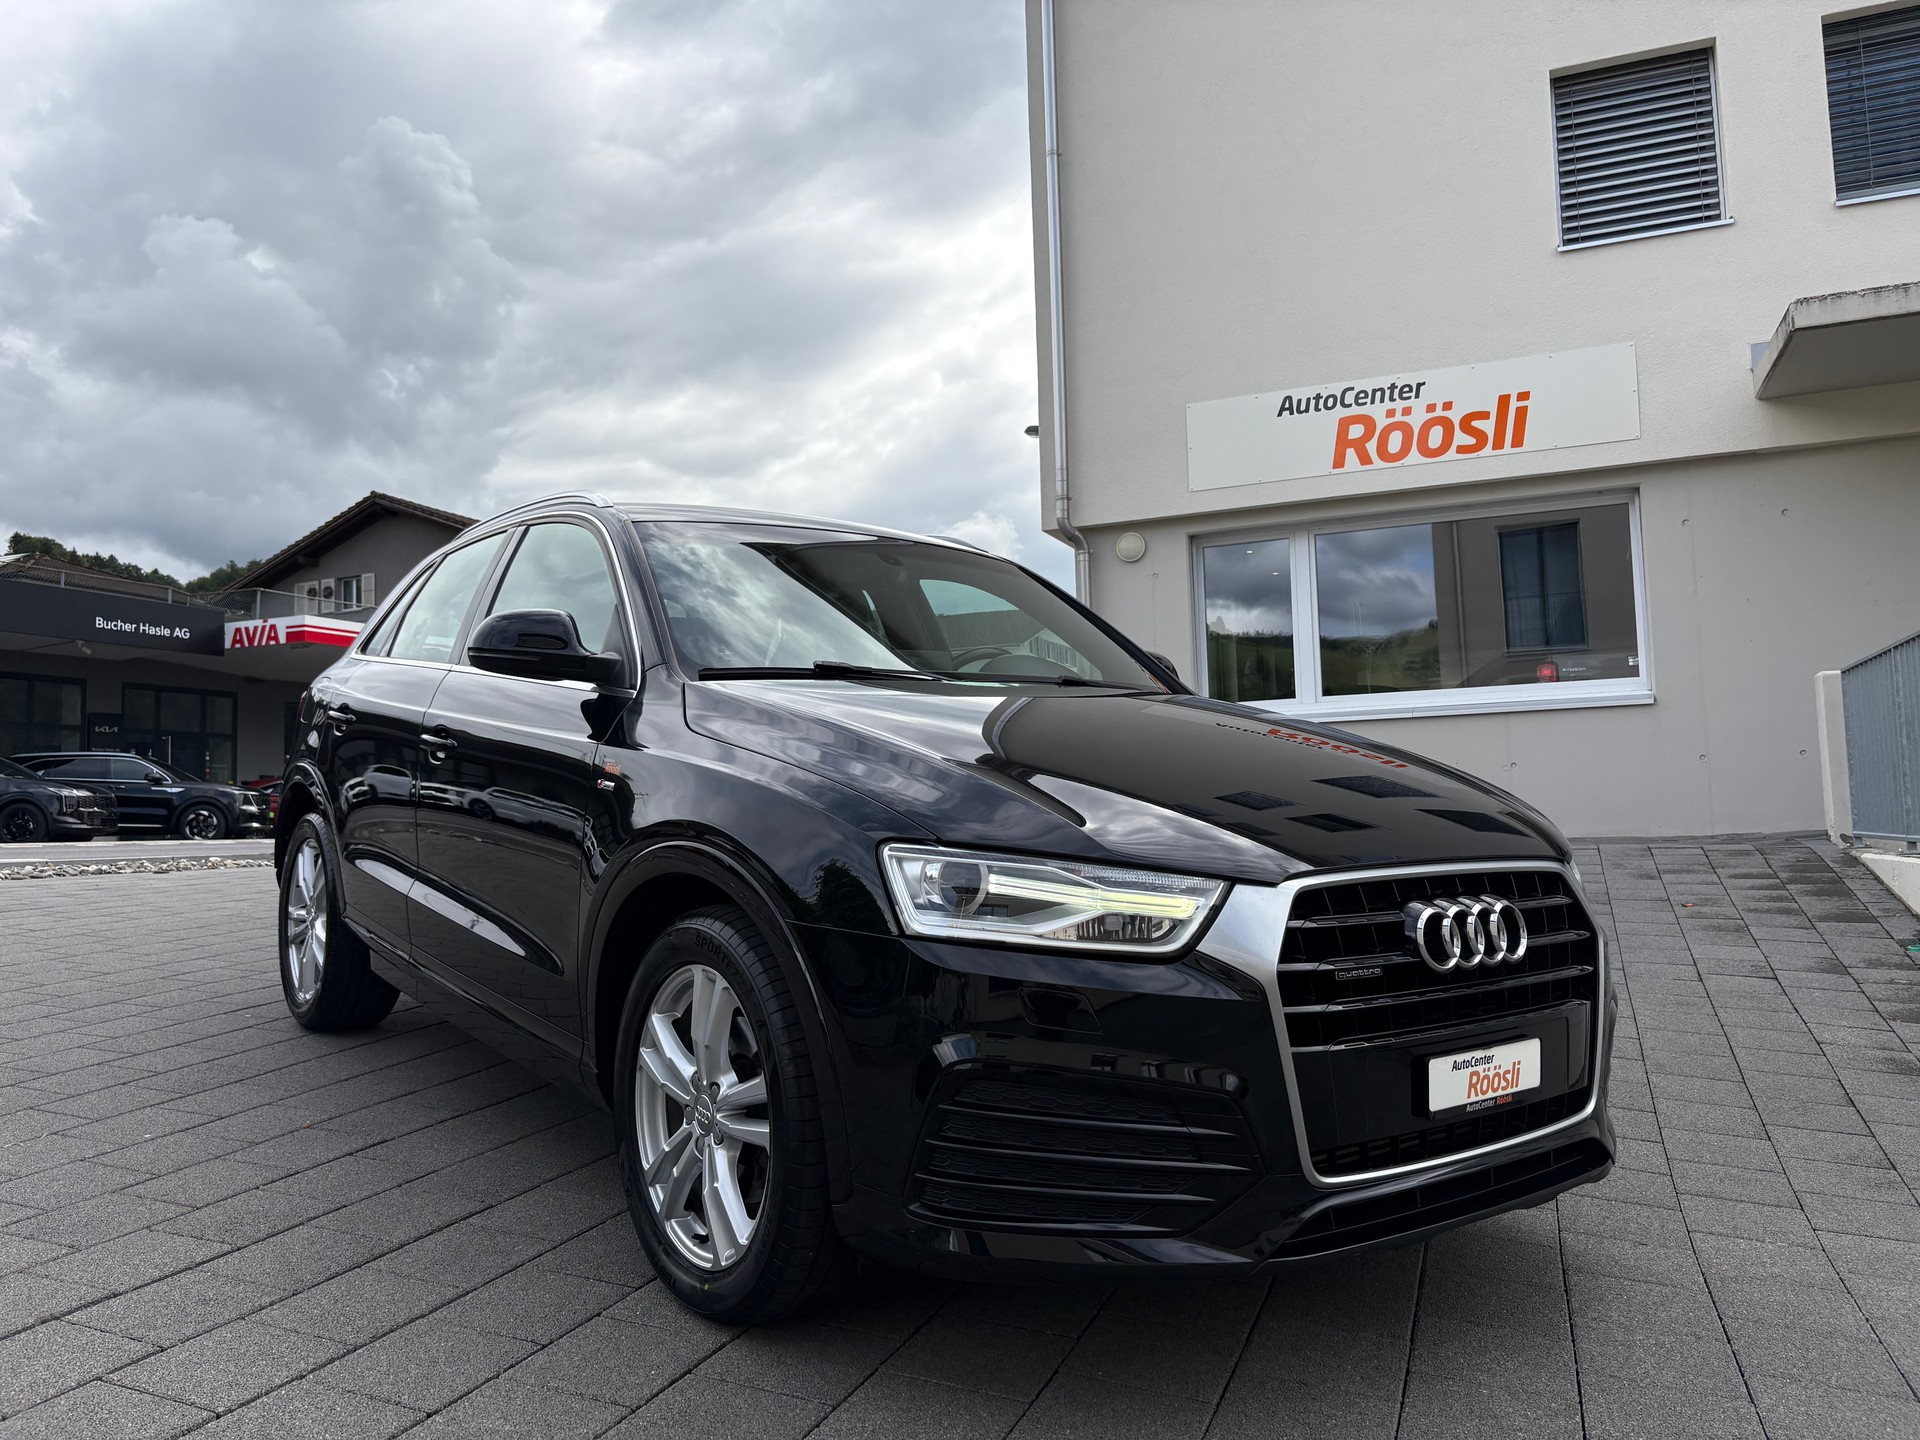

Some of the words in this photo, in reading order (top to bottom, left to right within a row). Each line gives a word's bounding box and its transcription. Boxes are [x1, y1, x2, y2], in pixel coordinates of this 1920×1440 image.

[1276, 380, 1427, 418] AutoCenter
[1331, 390, 1531, 470] Röösli
[95, 616, 137, 633] Bucher
[139, 622, 171, 637] Hasle
[173, 626, 190, 640] AG
[230, 619, 279, 649] AVIA
[95, 725, 118, 733] KIA
[1338, 968, 1381, 979] quattro
[1451, 1054, 1495, 1072] AutoCenter
[1466, 1060, 1521, 1100] Röösli
[1465, 1099, 1496, 1113] AutoCenter
[1496, 1093, 1513, 1105] Röösli
